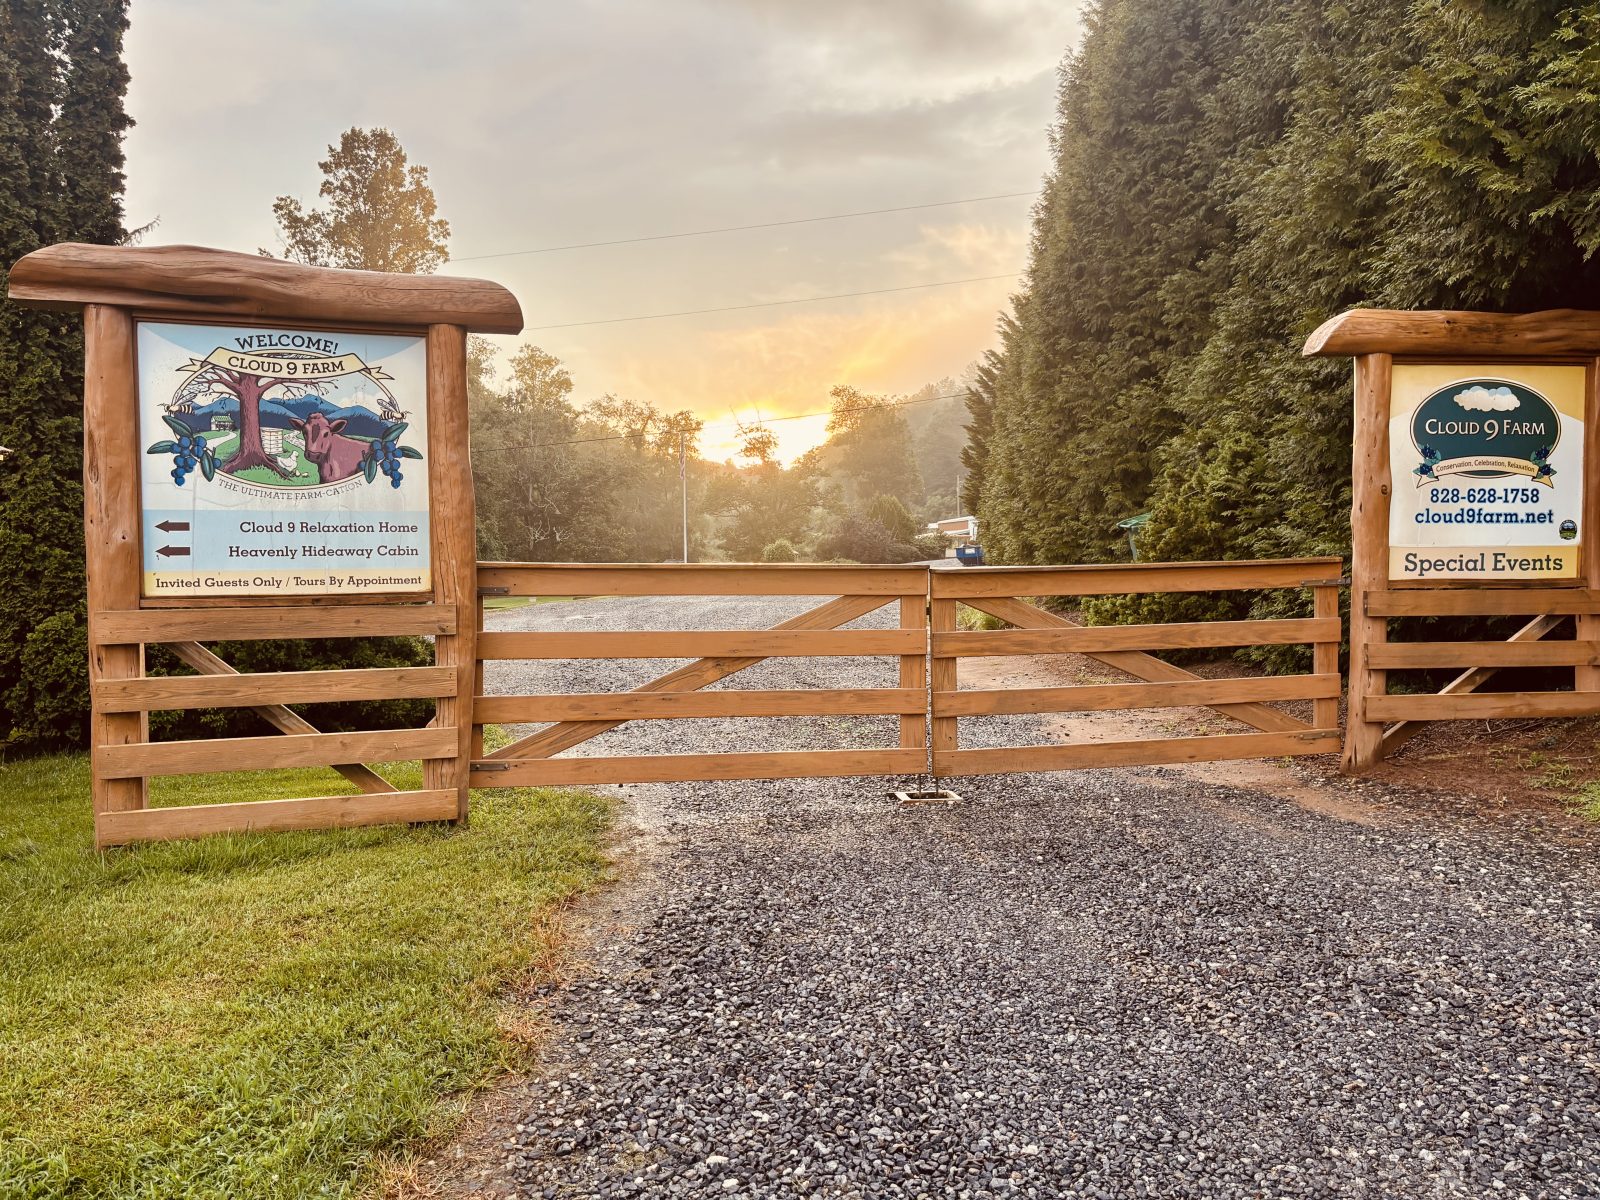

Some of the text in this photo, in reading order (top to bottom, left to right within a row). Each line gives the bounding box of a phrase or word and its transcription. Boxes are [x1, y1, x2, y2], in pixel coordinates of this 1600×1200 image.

[234, 333, 339, 355] WELCOME!
[228, 356, 345, 375] CLOUD 9 FARM
[1425, 418, 1545, 441] CLOUD 9 FARM
[1435, 459, 1535, 472] Conservation, Celebration, Relaxation
[218, 478, 363, 500] THE ULTIMATE FARM-CATION
[1430, 488, 1540, 504] 828-628-1758
[1415, 508, 1554, 524] cloud9farm.net
[239, 521, 418, 533] Cloud 9 Relaxation Home
[228, 545, 419, 559] Heavenly Hideaway Cabin
[1404, 552, 1563, 577] Special Events
[155, 577, 201, 588] Invited
[204, 577, 250, 587] Guests
[252, 577, 282, 588] Only
[294, 576, 325, 586] Tours
[329, 576, 345, 588] By
[347, 575, 422, 587] Appointment
